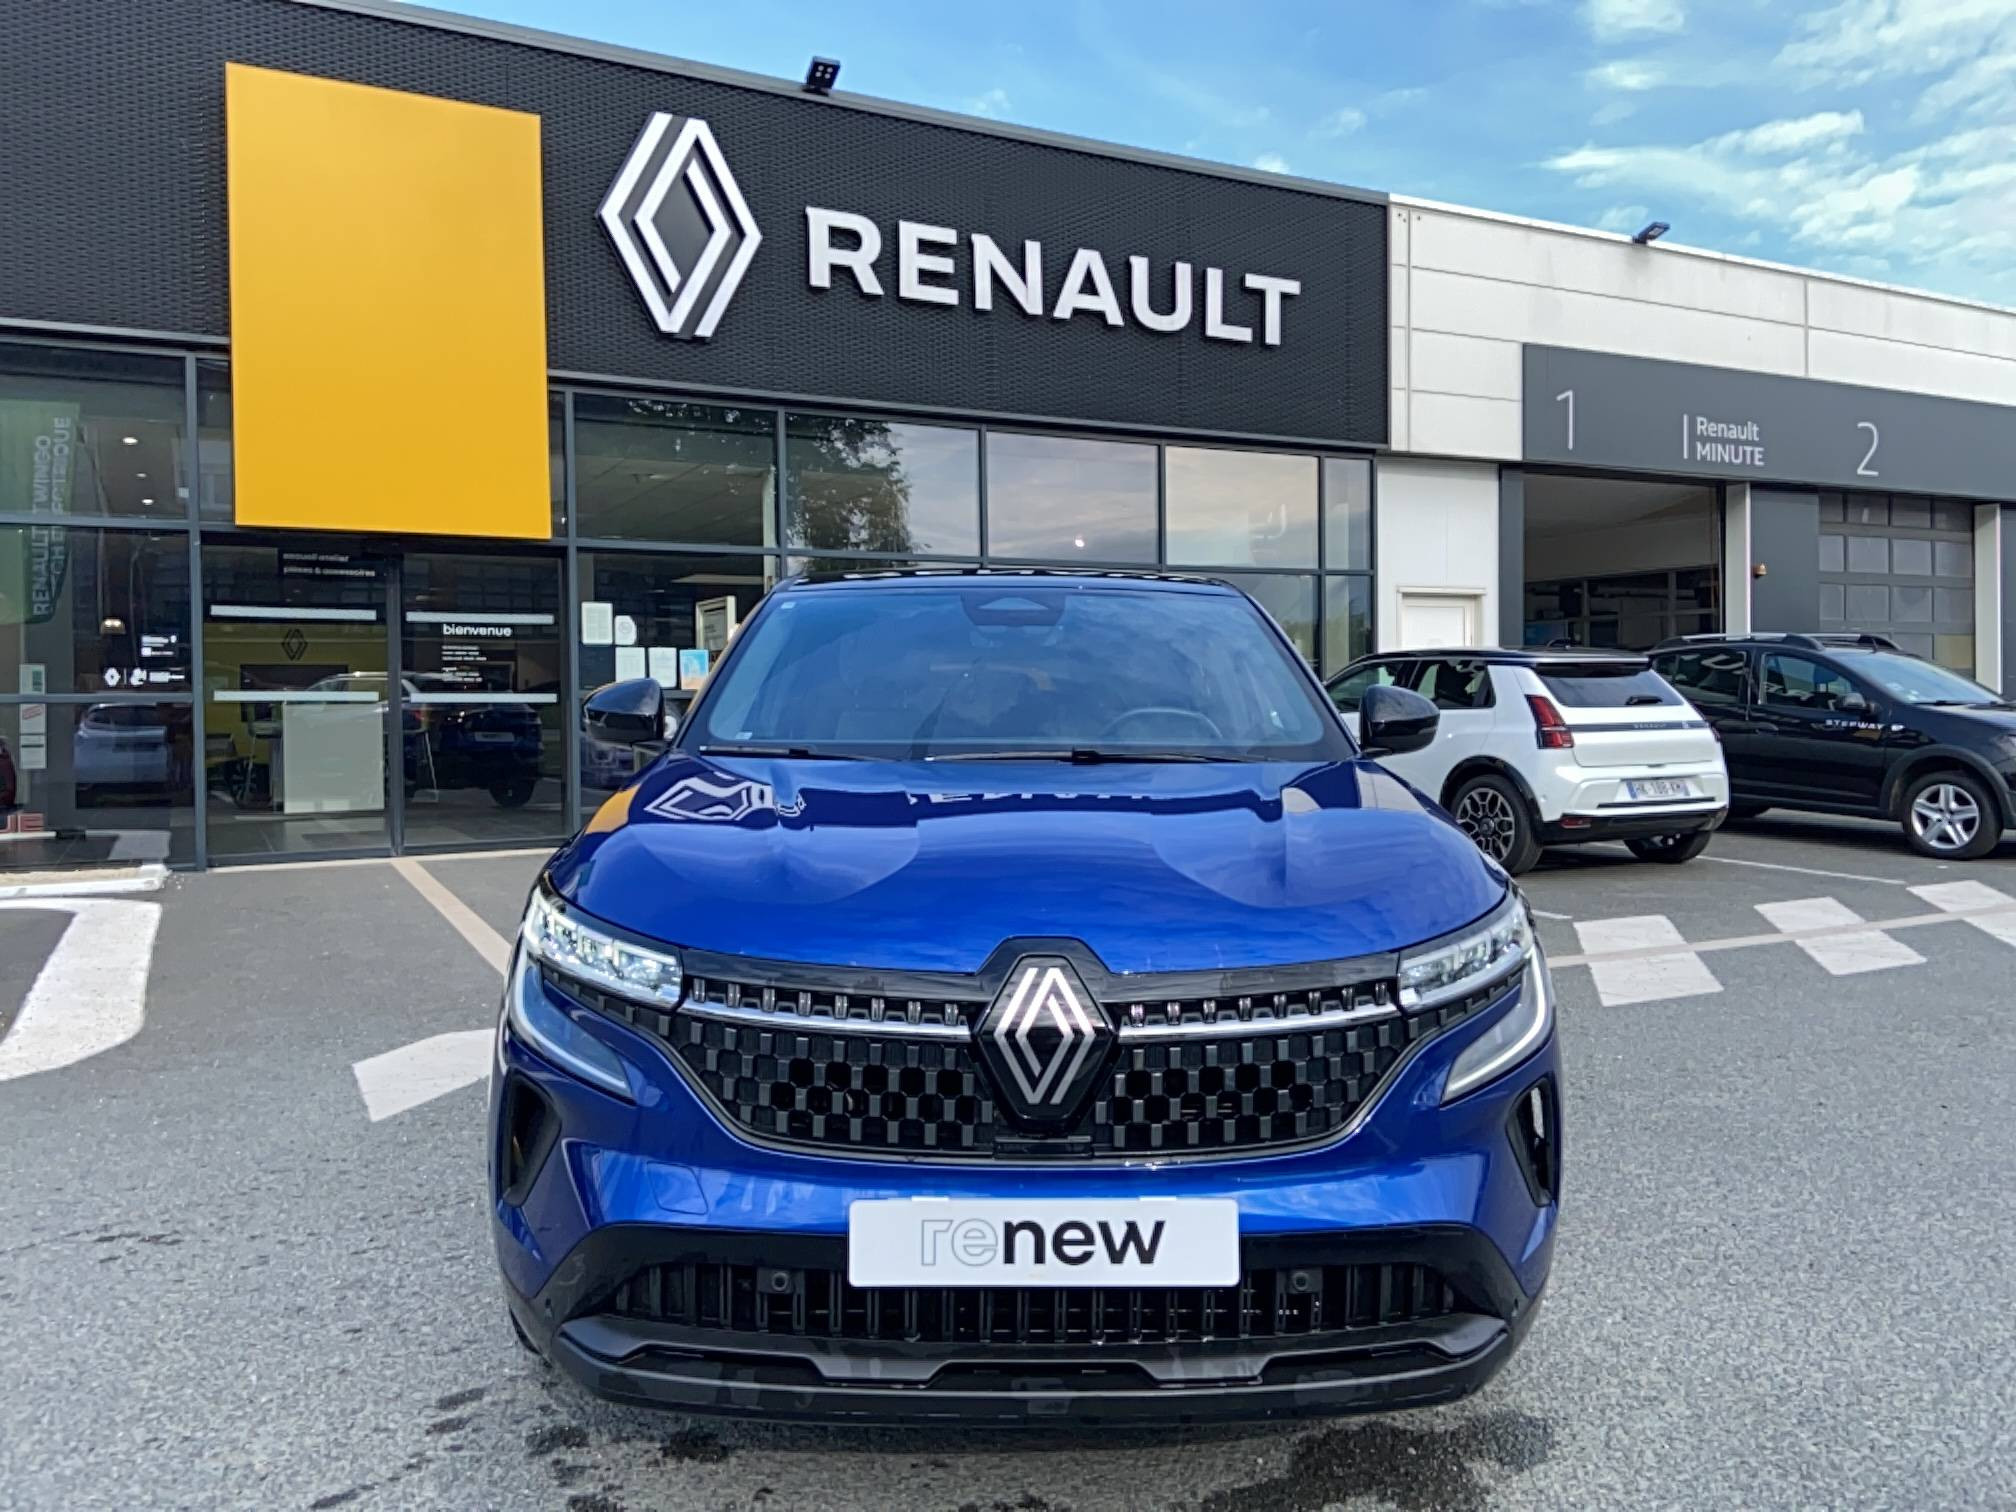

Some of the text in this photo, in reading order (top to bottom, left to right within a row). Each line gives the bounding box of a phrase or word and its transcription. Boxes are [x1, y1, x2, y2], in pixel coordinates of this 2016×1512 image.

[806, 206, 1301, 345] RENAULT
[1556, 389, 1575, 450] 1
[1696, 415, 1760, 442] Renault
[1696, 440, 1765, 467] MINUTE
[1856, 421, 1880, 477] 2
[32, 435, 51, 616] RENAULT TWINGO
[442, 623, 512, 638] bienvenue
[1825, 719, 1885, 730] STEPWAY
[921, 1218, 1166, 1267] renew
